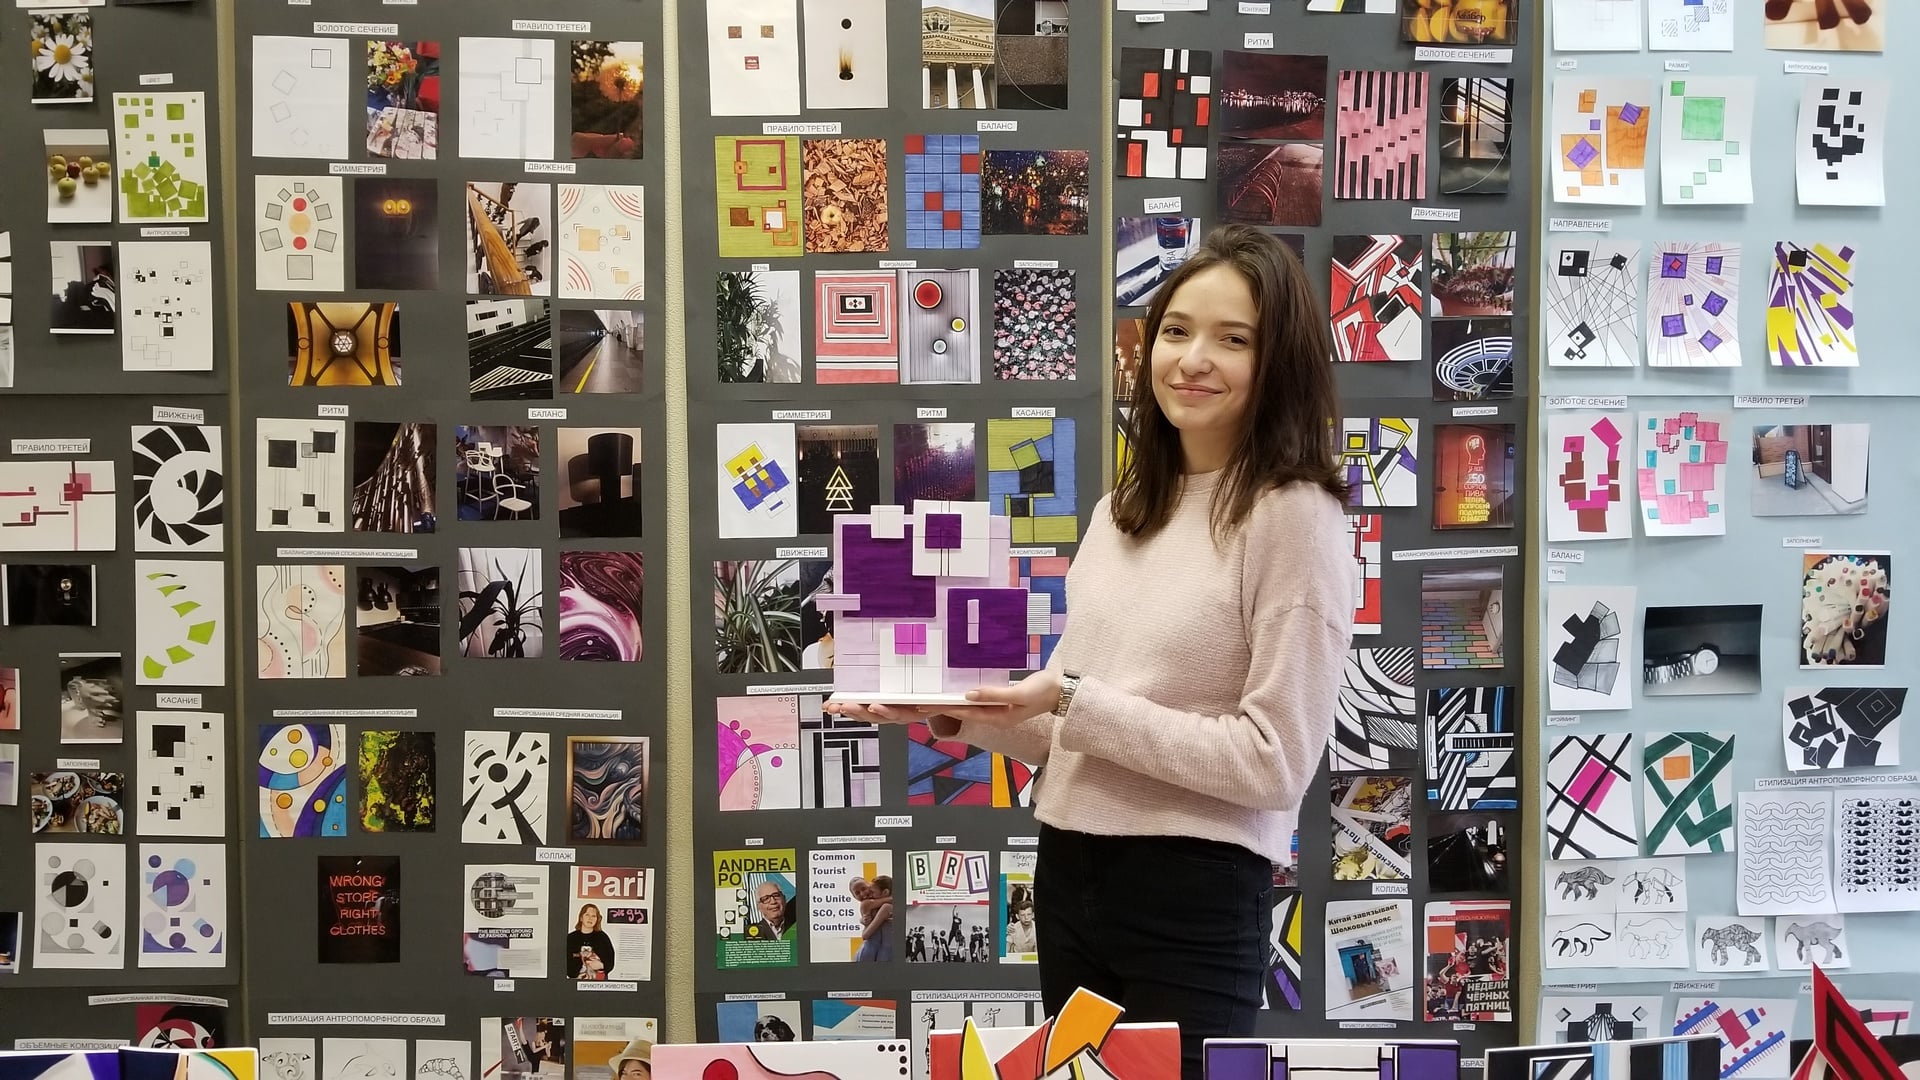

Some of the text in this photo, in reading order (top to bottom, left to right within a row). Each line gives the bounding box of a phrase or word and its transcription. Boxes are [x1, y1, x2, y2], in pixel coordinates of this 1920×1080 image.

[317, 25, 395, 34] ЗОЛОТОЕ СЕЧЕНИЕ
[515, 22, 586, 31] ПРАВИЛО ТРЕТЕЙ
[1419, 49, 1496, 59] ЗОЛОТОЕ СЕЧЕНИЕ
[767, 123, 837, 133] ПРАВИЛО ТРЕТЕЙ
[981, 122, 1013, 130] БАЛАНС
[528, 163, 574, 172] ДВИЖЕНИЕ
[1148, 200, 1180, 210] БАЛАНС
[1414, 209, 1458, 219] ДВИЖЕНИЕ
[1553, 220, 1609, 229] НАПРАВЛЕНИЕ
[1549, 398, 1586, 406] ЗОЛОТОЕ
[1737, 396, 1805, 405] ПРАВИЛО ТРЕТЕЙ
[158, 410, 204, 420] ДВИЖЕНИЕ
[321, 407, 345, 415] РИТМ
[531, 410, 564, 418] БАЛАНС
[17, 443, 88, 452] ПРАВИЛО ТРЕТЕЙ
[781, 549, 823, 557] ДВИЖЕНИЕ
[1395, 550, 1452, 558] СБАЛАНСИРОВАННАЯ
[1480, 547, 1517, 555] КОМПОЗИЦИЯ
[1551, 551, 1581, 560] БАЛАНС
[160, 696, 198, 705] КАСАНИЕ
[1759, 778, 1807, 787] СТИЛИЗАЦИЯ
[1808, 775, 1886, 785] АНТРОПОМОРФНОГО
[877, 817, 910, 825] КОЛЛАЖ
[539, 851, 571, 859] КОЛЛАЖ
[812, 853, 855, 861] Common
[718, 858, 791, 872] ANDREA
[916, 858, 925, 876] B
[946, 856, 957, 876] R
[812, 867, 846, 875] Tourist
[330, 875, 382, 887] WRONG
[581, 870, 644, 897] Pari
[718, 872, 742, 886] PO
[812, 881, 835, 889] Area
[1375, 886, 1408, 894] КОЛЛАЖ
[336, 892, 378, 903] STORE
[812, 895, 851, 903] to Unite
[340, 909, 377, 919] RIGHT
[812, 909, 854, 918] SCO, CIS
[1328, 904, 1398, 926] Китай завязывает
[1373, 916, 1392, 926] пояс
[330, 925, 385, 935] CLOTHES
[812, 923, 860, 931] Countries
[1467, 980, 1509, 991] НЕДЕЛИ
[1673, 982, 1714, 990] ДВИЖЕНИЕ
[916, 992, 967, 1000] СТИЛИЗАЦИЯ
[1465, 1001, 1510, 1012] ПЯТНИЦ
[271, 1015, 440, 1024] СТИЛИЗАЦИЯ АНТРОПОМОРФНОГО ОБРАЗА
[19, 1041, 126, 1050] ОБЪЕМНЫЕ КОМПОЗИЦИ
